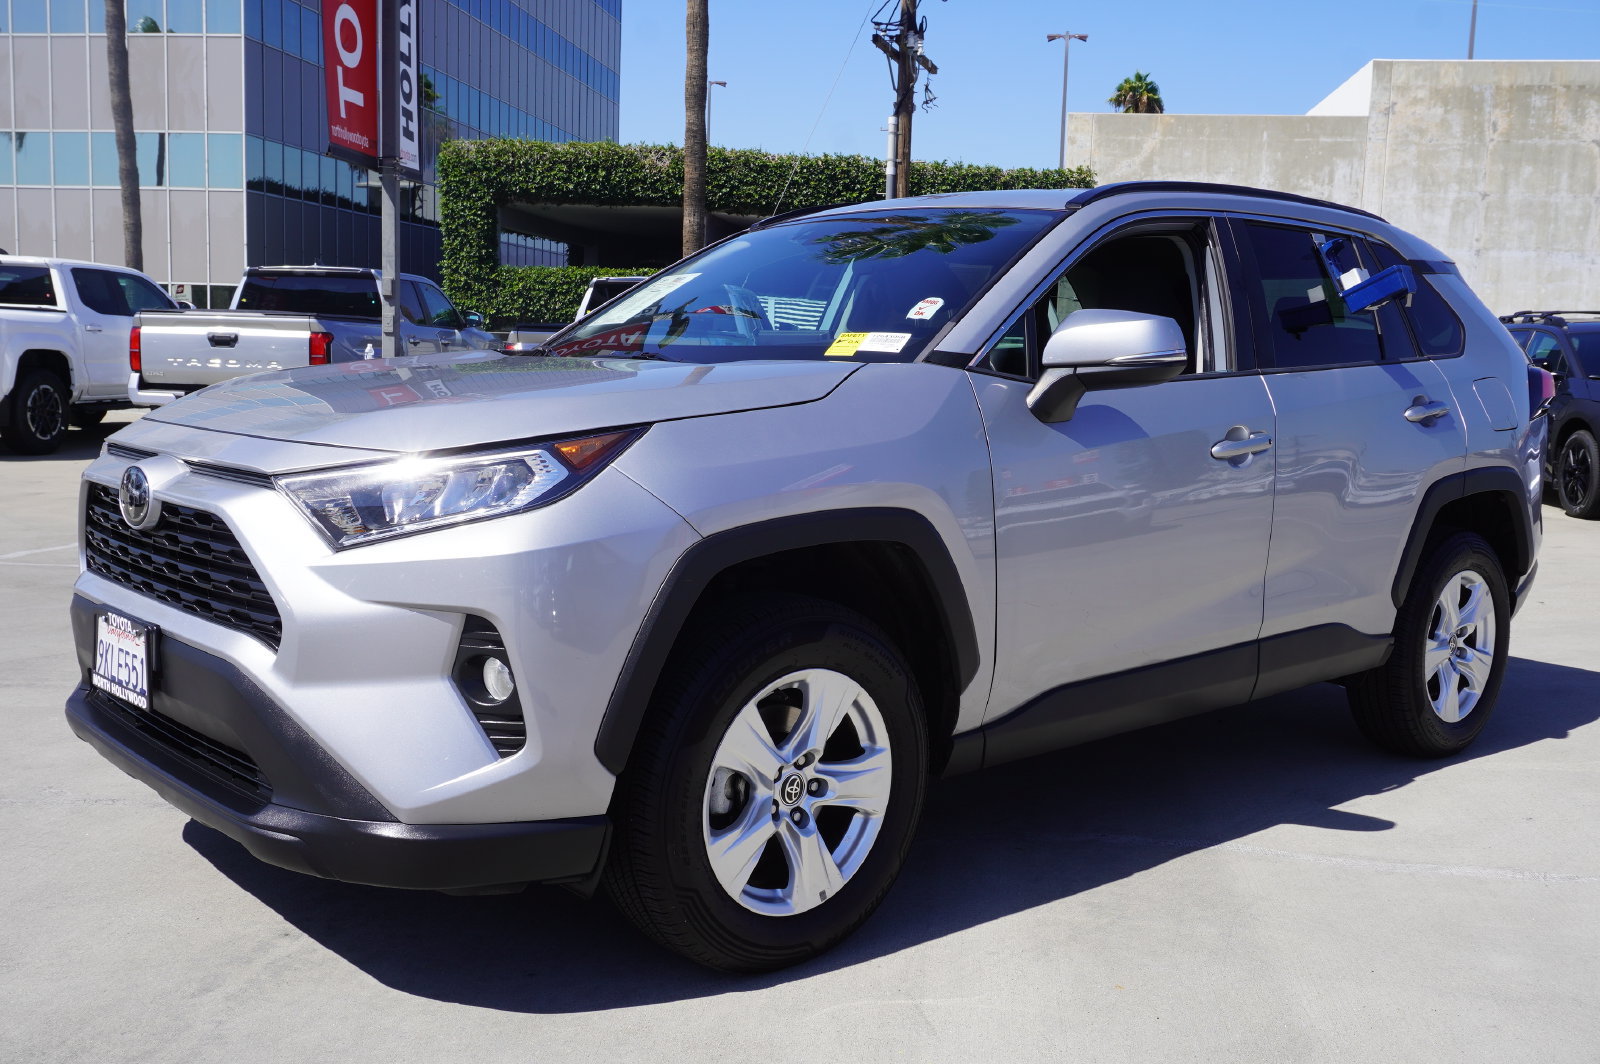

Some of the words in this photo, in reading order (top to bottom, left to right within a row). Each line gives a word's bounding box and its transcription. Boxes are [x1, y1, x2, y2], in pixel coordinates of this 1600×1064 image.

[108, 612, 132, 634] TOYOTA
[97, 639, 147, 696] 9KLE551
[92, 673, 111, 693] NORTH
[111, 682, 147, 708] HOLLYWOOD
